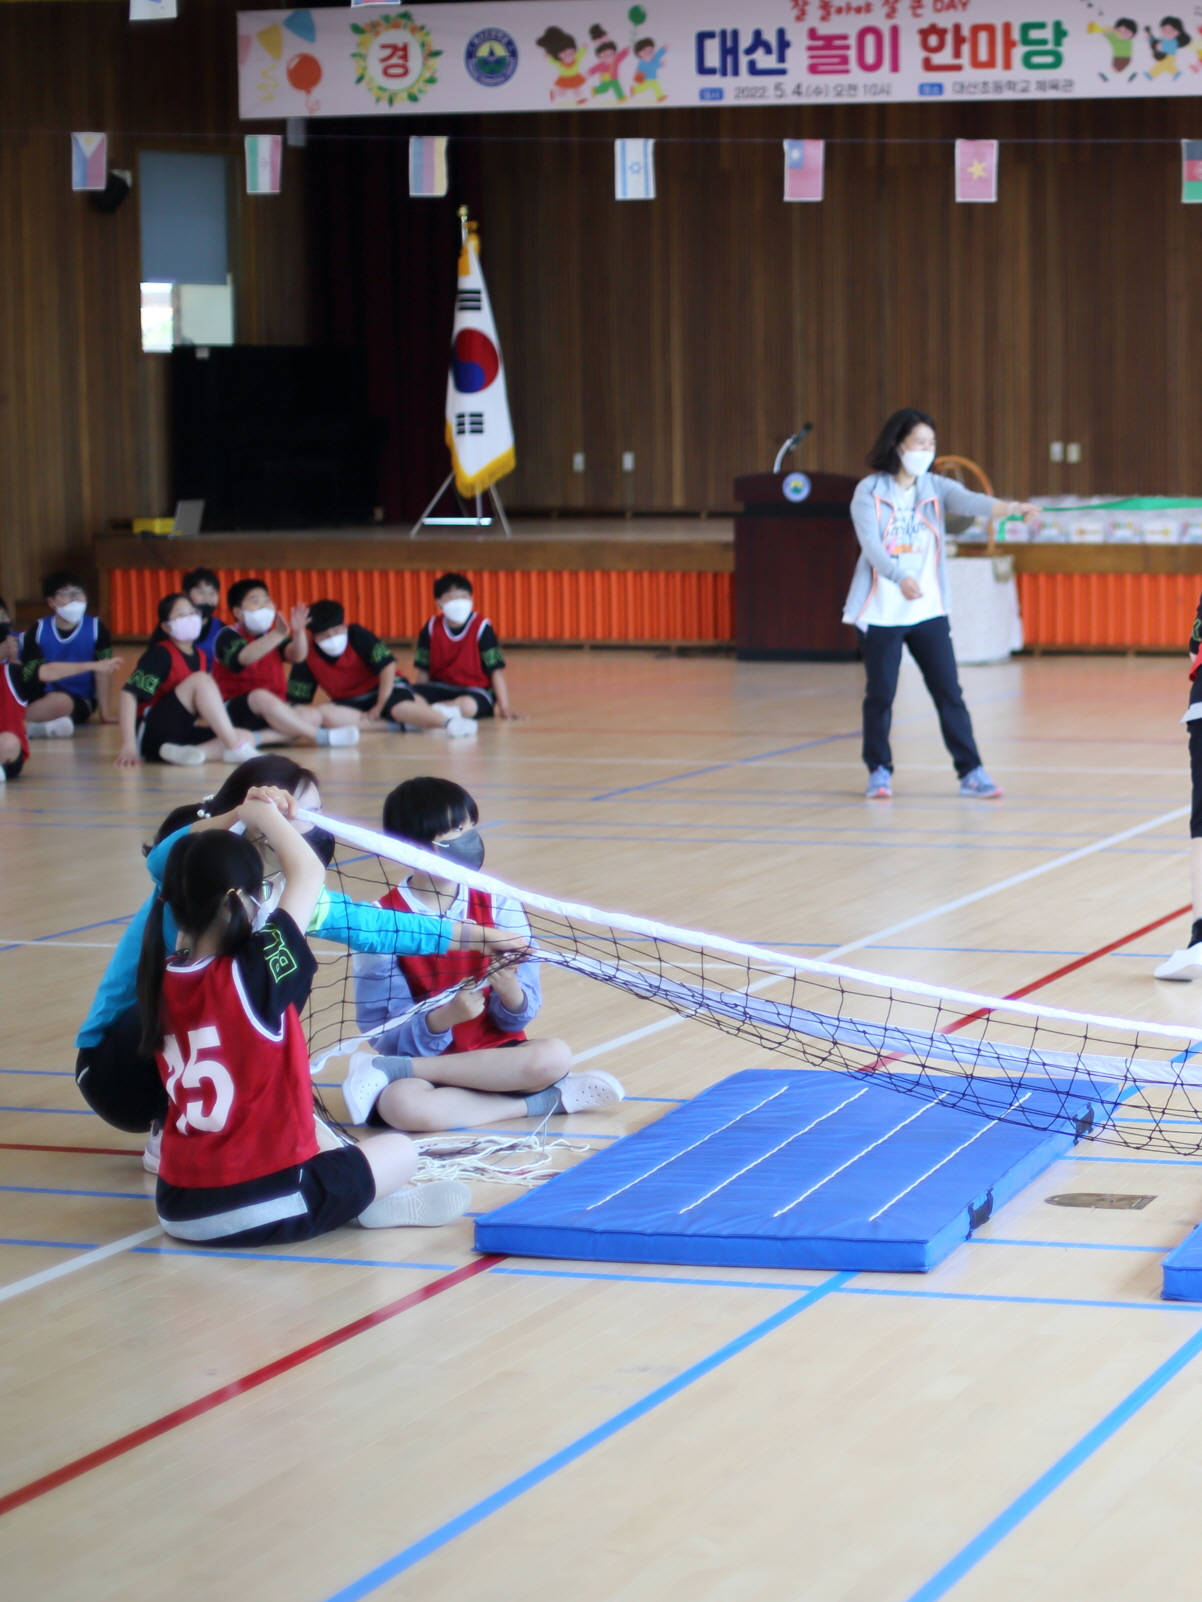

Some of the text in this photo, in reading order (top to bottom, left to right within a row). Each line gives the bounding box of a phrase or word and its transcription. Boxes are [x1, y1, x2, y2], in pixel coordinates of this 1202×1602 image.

[379, 42, 410, 78] 경
[695, 20, 1069, 77] 대산 놀이 한마당
